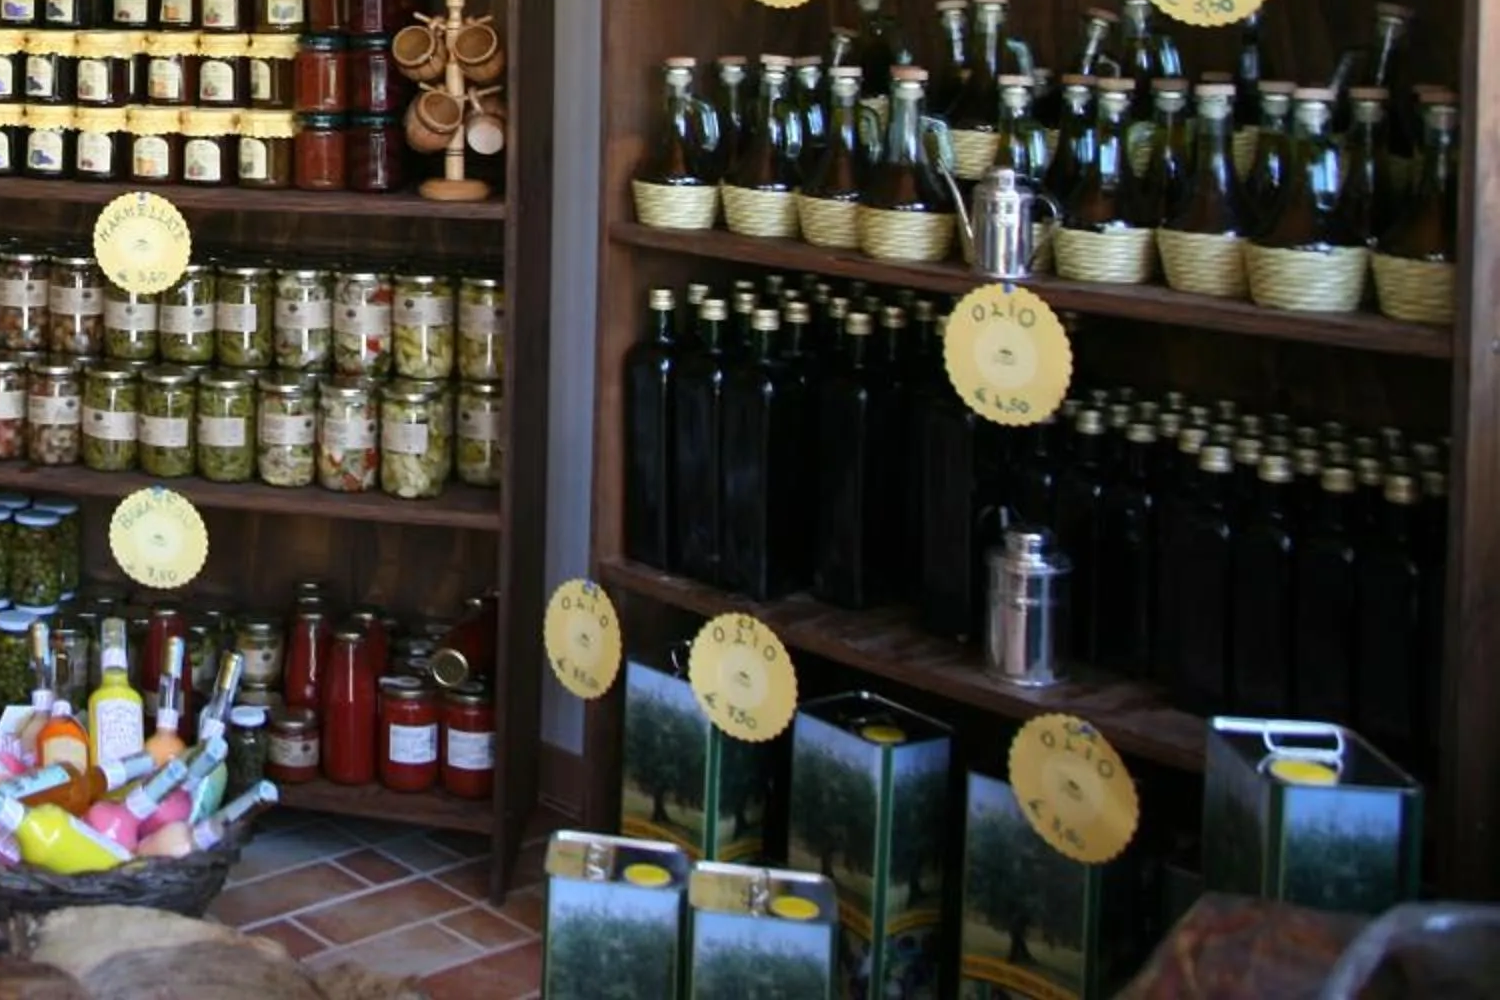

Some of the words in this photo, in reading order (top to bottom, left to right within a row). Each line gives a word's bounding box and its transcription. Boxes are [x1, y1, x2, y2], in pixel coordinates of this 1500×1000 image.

[971, 301, 1037, 329] OLIO
[561, 596, 609, 629] OLIO
[713, 627, 777, 662] OLIO
[1040, 730, 1115, 780] OLIO
